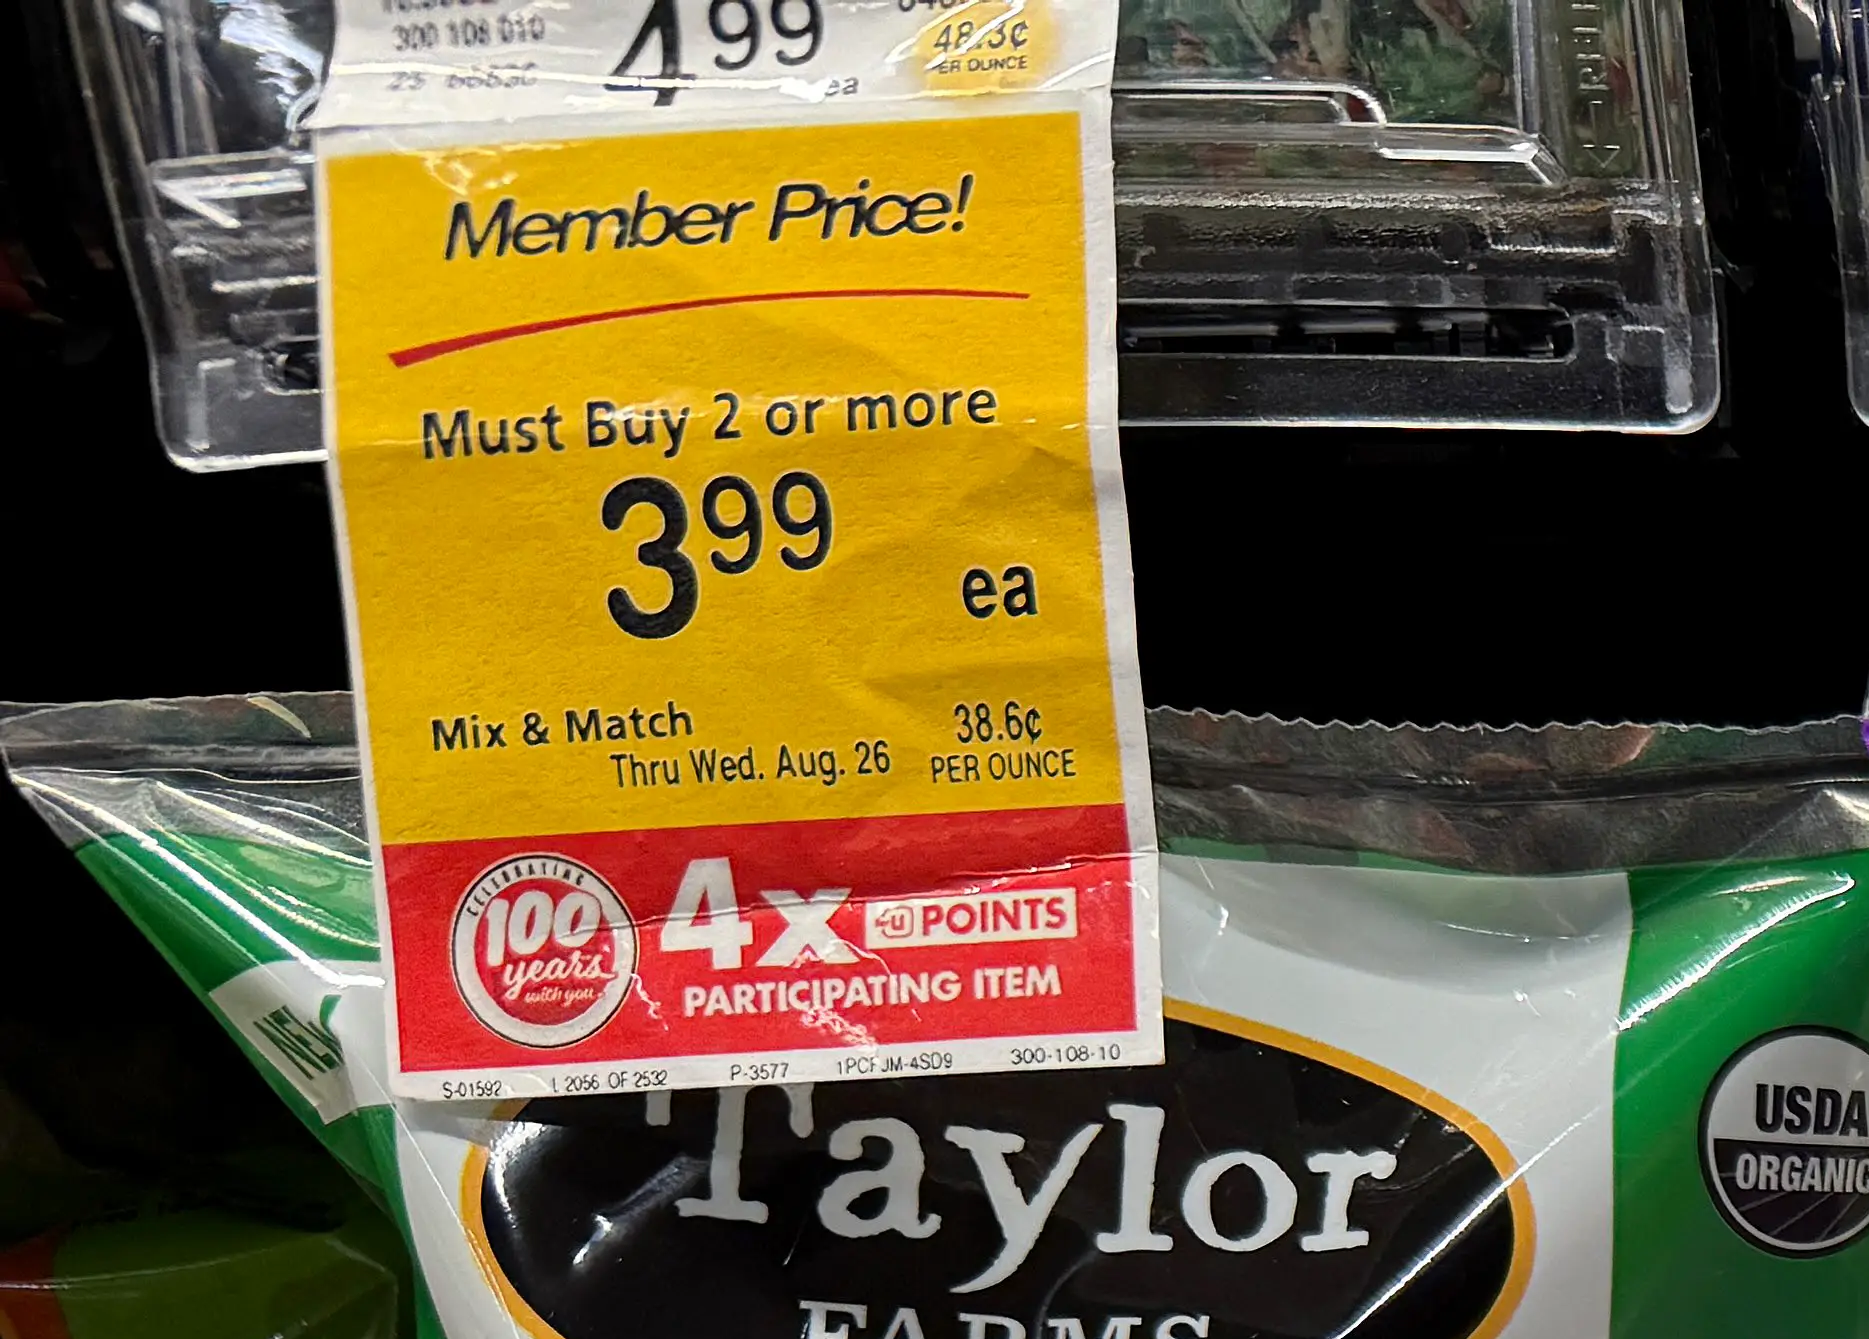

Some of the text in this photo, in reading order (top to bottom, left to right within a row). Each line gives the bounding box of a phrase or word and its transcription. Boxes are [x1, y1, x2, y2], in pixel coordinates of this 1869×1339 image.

[444, 174, 975, 261] Member Price!
[431, 701, 694, 752] Mix & Match
[953, 703, 1042, 744] 38.6¢
[611, 741, 891, 788] Thru Wed. Aug. 26
[931, 749, 1076, 783] PER OUNCE
[922, 898, 1071, 937] POINTS
[684, 964, 1063, 1019] PARTICIPATING ITEM
[1011, 1044, 1120, 1065] 300-108-10
[1754, 1083, 1869, 1138] USDA
